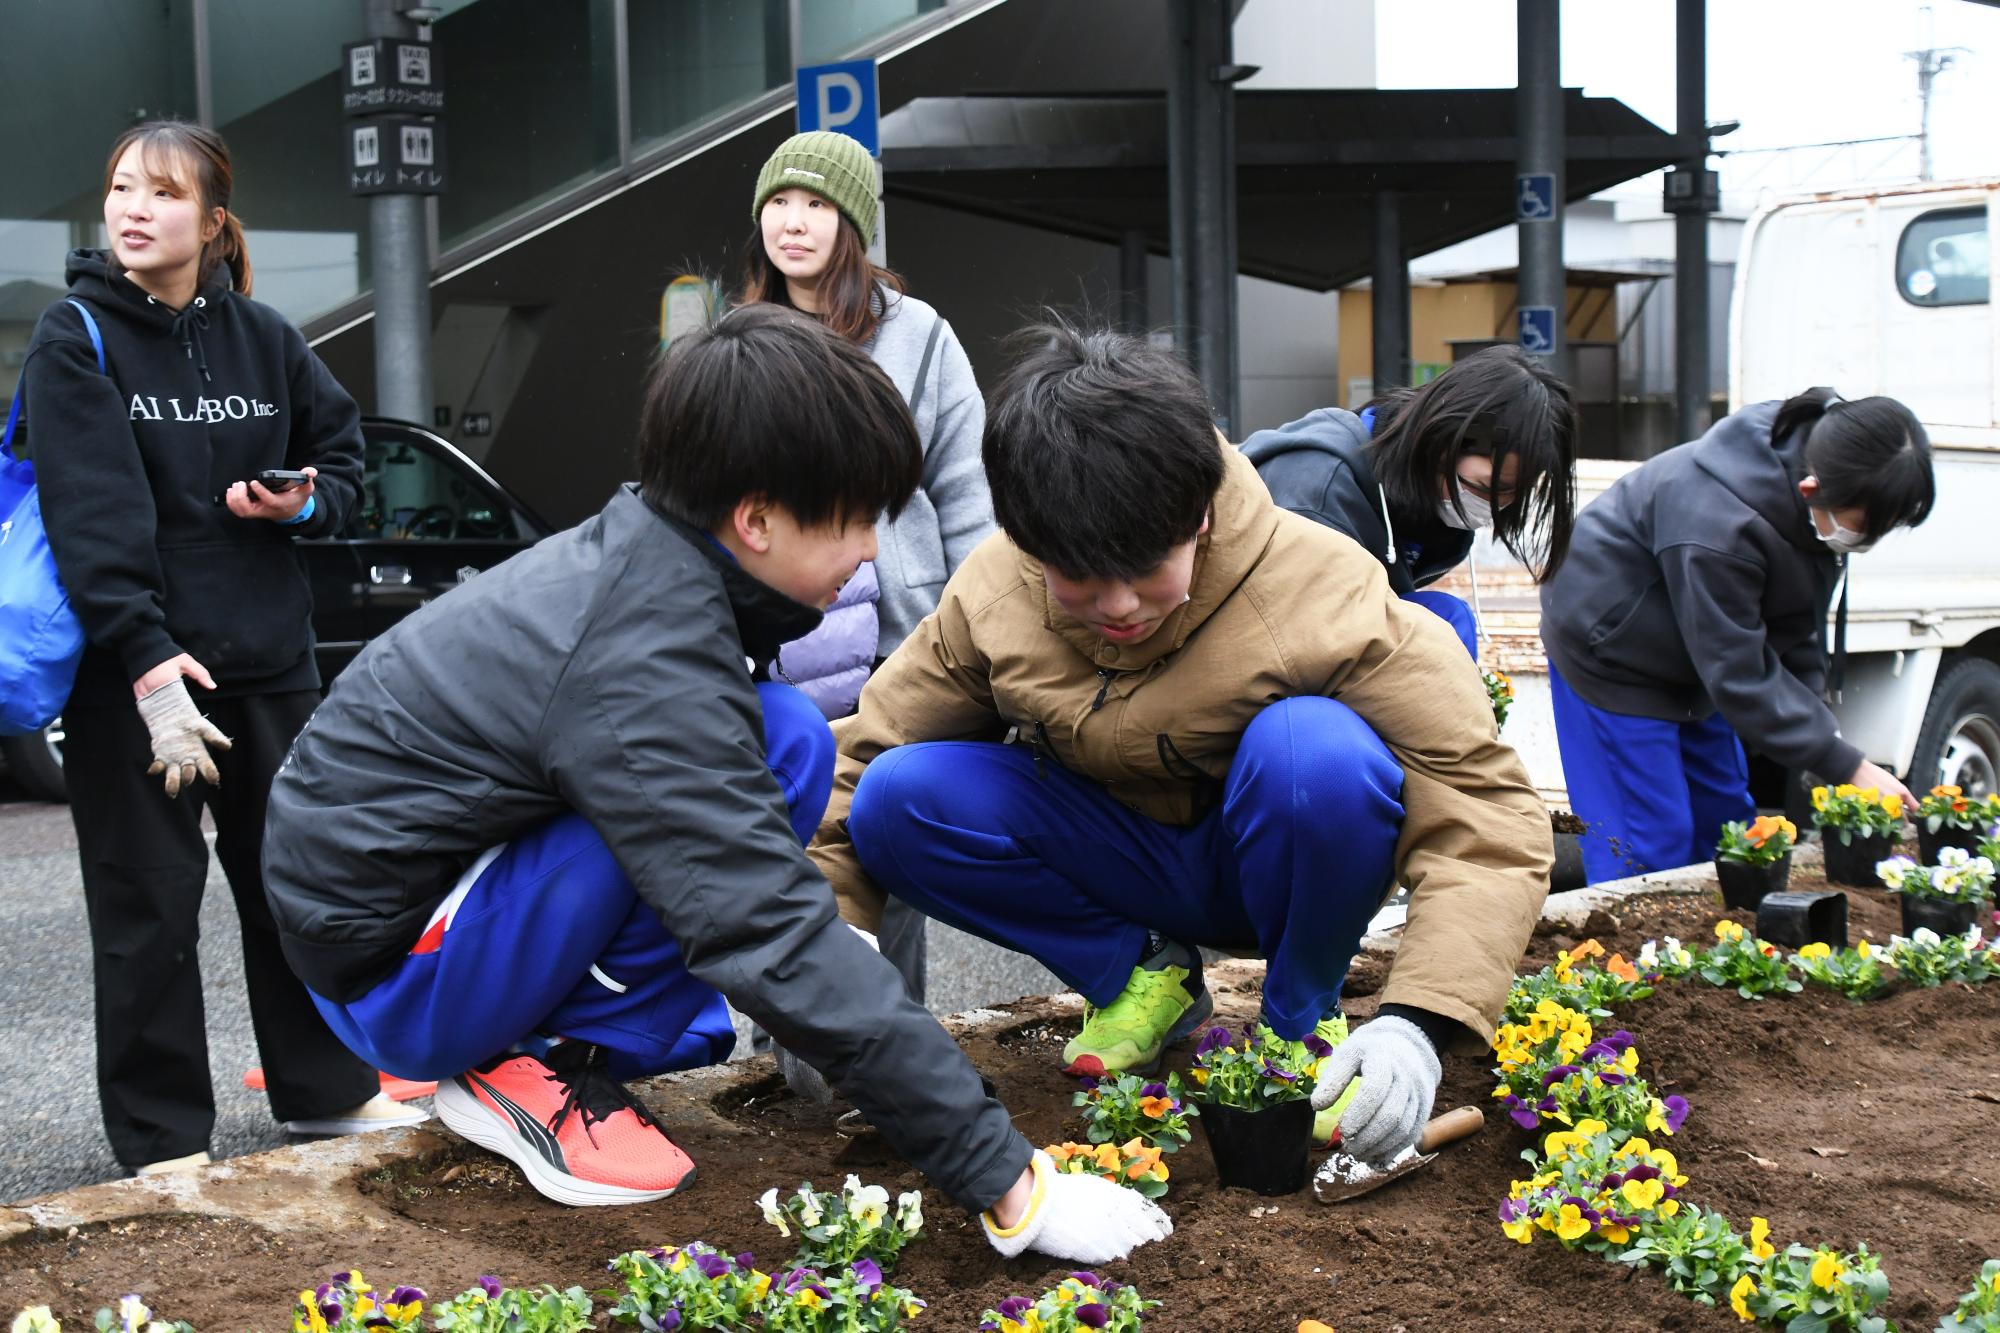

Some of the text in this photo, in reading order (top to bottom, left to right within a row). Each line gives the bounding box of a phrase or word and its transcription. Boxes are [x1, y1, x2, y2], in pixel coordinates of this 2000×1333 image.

[817, 73, 862, 131] P
[352, 169, 386, 188] トイレ
[396, 168, 442, 187] トイレ
[168, 395, 248, 423] LABO
[250, 399, 279, 417] Inc.
